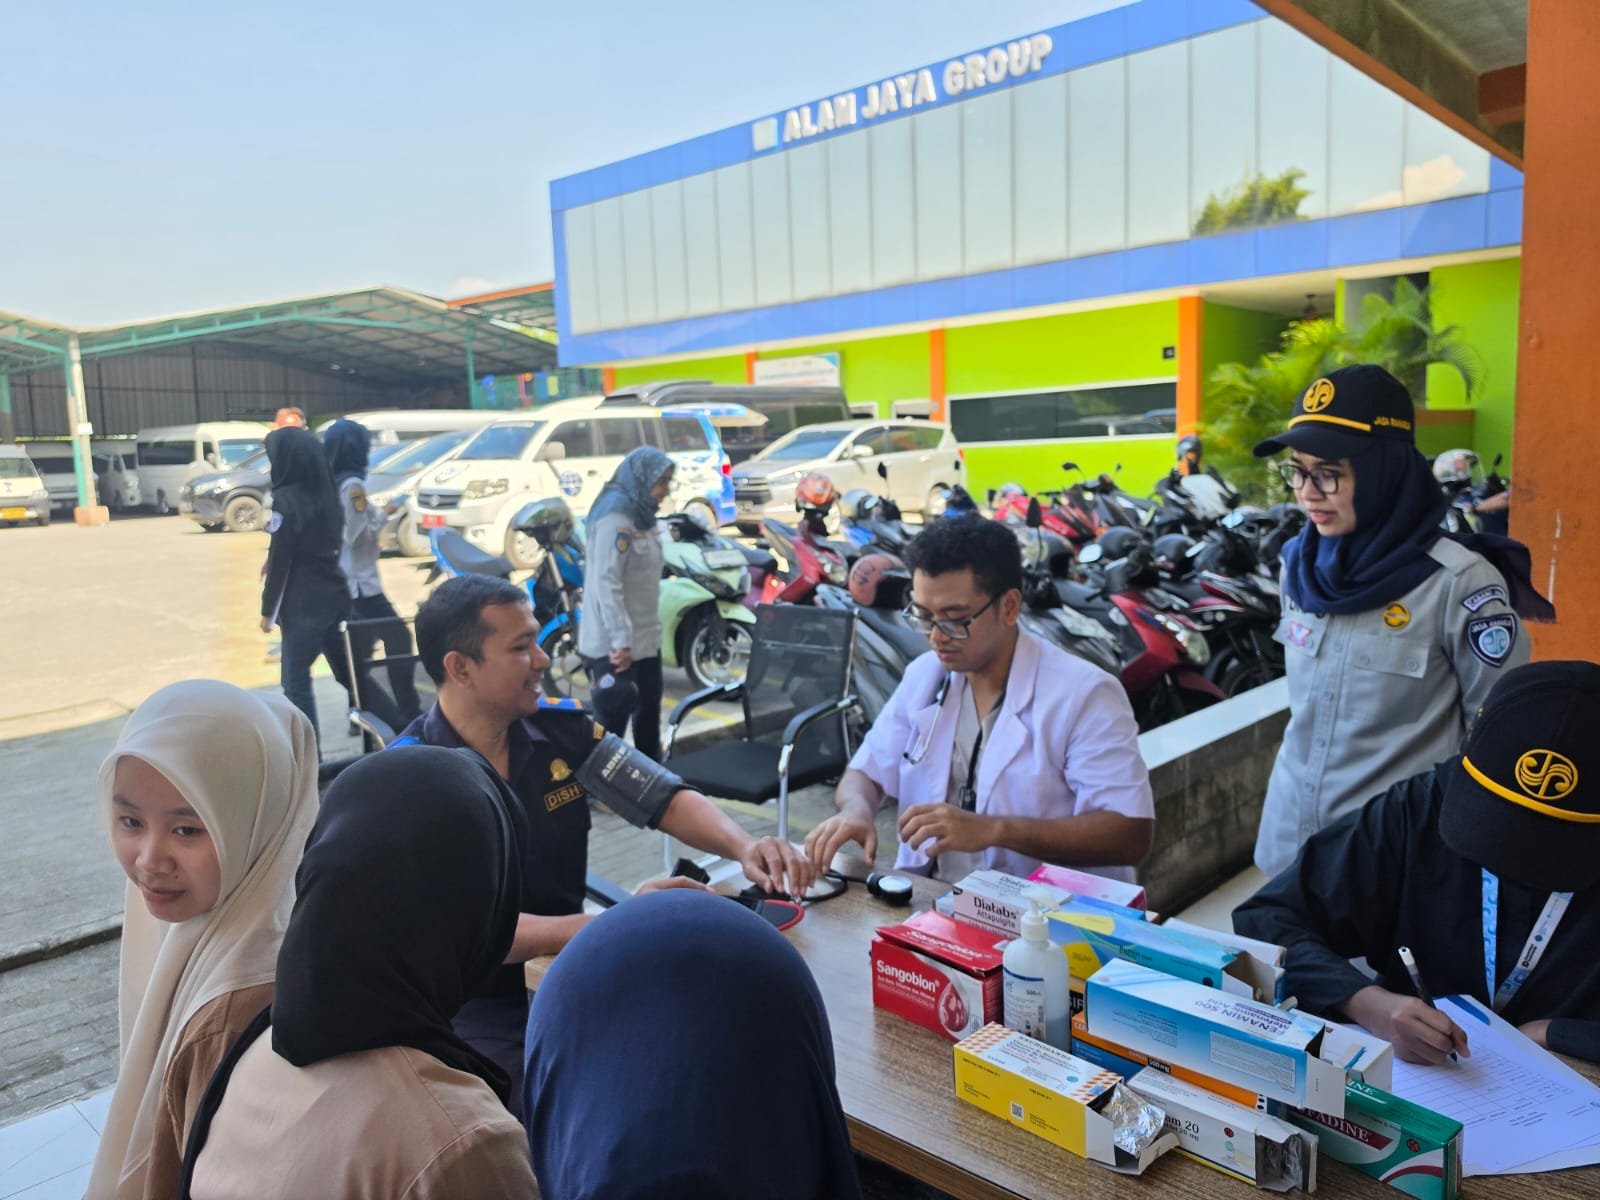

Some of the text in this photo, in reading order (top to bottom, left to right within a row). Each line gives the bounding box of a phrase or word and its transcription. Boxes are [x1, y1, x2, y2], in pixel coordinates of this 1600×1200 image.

[783, 34, 1053, 142] ALAM JAYA GROUP
[548, 785, 580, 807] DISH
[974, 896, 1017, 920] Diatabs
[876, 959, 936, 993] Sangobion
[1222, 1009, 1285, 1035] FENAMIN
[1347, 1080, 1374, 1095] INE
[1164, 1114, 1181, 1127] am
[1184, 1119, 1199, 1134] 20
[1306, 1108, 1369, 1142] FADINE
